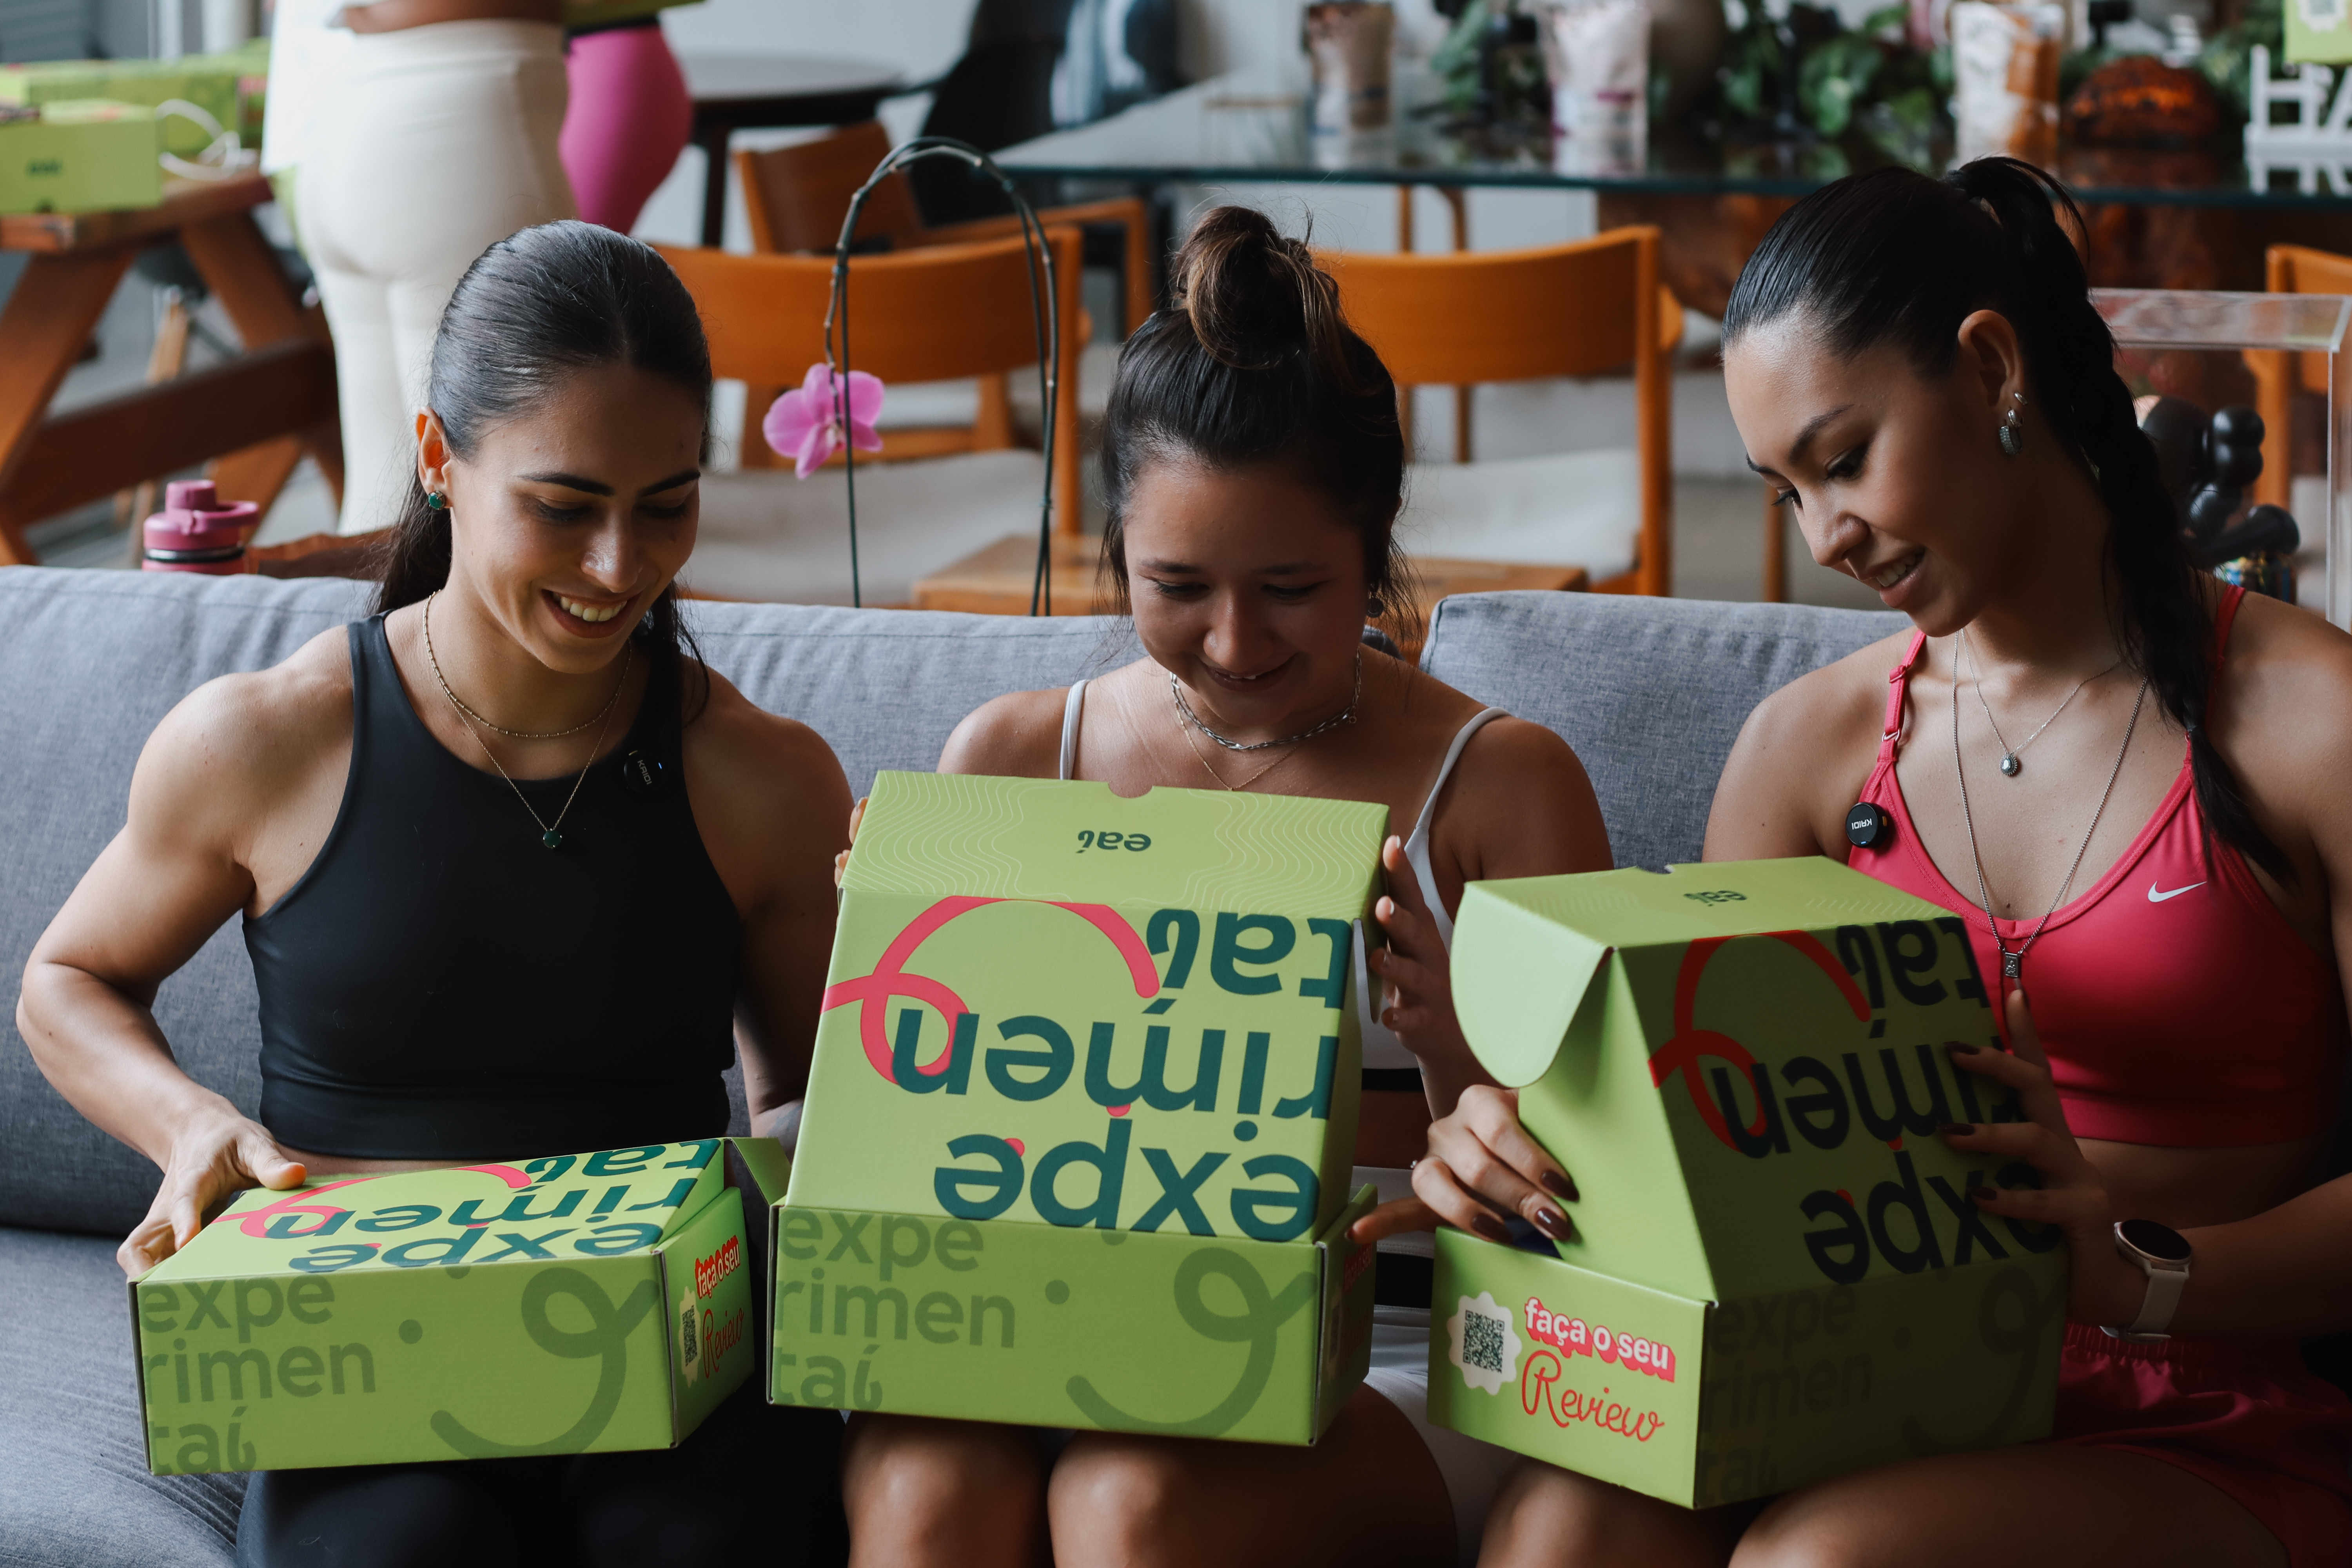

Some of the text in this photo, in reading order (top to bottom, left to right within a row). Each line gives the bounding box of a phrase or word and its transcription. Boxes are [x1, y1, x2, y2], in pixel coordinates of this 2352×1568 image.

[637, 759, 652, 784] KAIDI
[1076, 830, 1151, 853] eaí
[1851, 818, 1872, 829] KAIDI
[1142, 908, 1352, 1015] taí
[1836, 916, 1991, 1038] taí
[892, 1008, 1339, 1142] rimen
[265, 1178, 698, 1239] rimen
[934, 1118, 1321, 1242] expe
[289, 1223, 663, 1273] expe
[698, 1244, 740, 1297] faça o seu
[778, 1208, 984, 1281] expe
[140, 1274, 335, 1343] expe
[774, 1267, 1015, 1348] rimen
[1526, 1298, 1669, 1370] faça o seu
[142, 1338, 376, 1405] rimen
[702, 1308, 744, 1379] Review
[1522, 1350, 1665, 1442] Review
